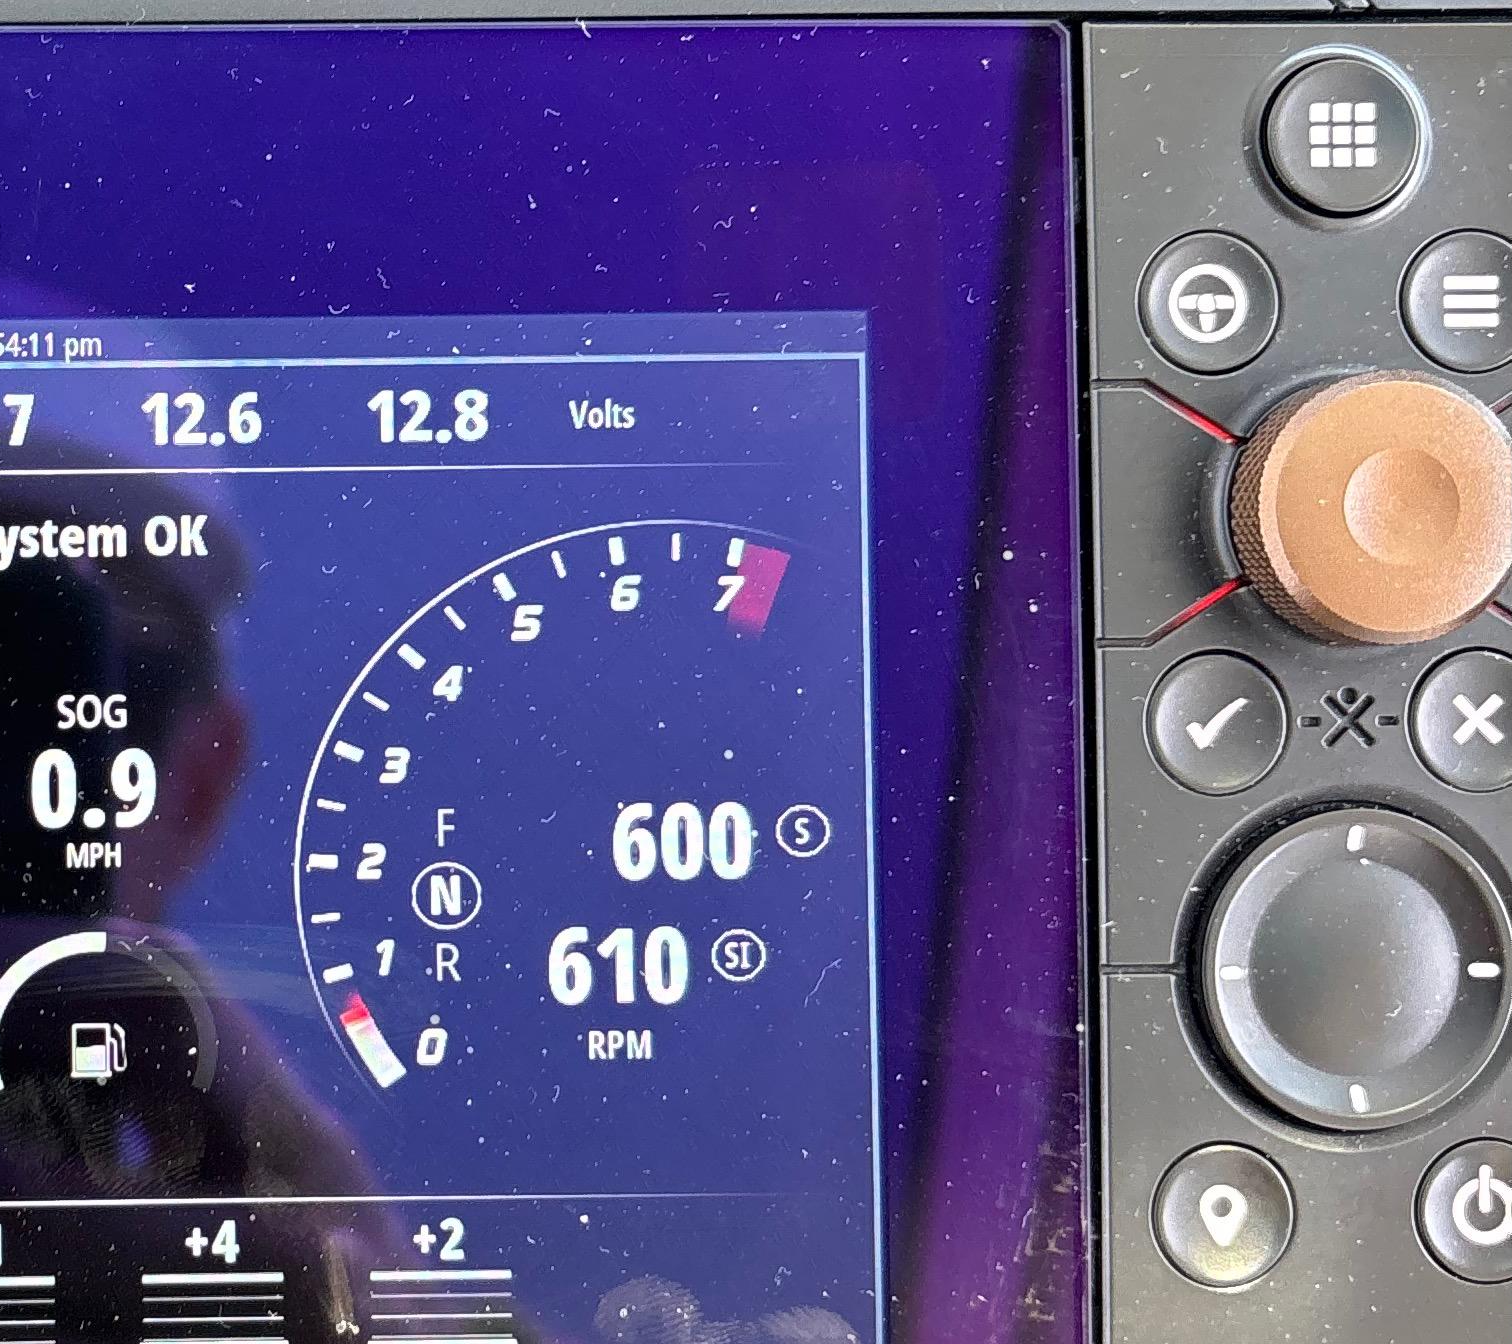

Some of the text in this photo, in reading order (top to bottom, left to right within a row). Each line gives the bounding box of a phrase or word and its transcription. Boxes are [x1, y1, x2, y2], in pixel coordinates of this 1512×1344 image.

[64, 336, 102, 362] pm
[141, 391, 263, 446] 12.6
[367, 389, 490, 444] 12.8
[568, 399, 635, 431] Volts
[143, 514, 209, 557] OK
[610, 575, 641, 611] 6
[713, 576, 744, 612] 7
[511, 604, 544, 642] 5
[433, 665, 464, 703] 4
[56, 695, 128, 730] SOG
[379, 747, 411, 784] 3
[30, 747, 157, 830] 0.9
[438, 809, 456, 848] F
[612, 802, 811, 882] 600 S
[65, 841, 122, 870] MPH
[356, 844, 388, 881] 2
[430, 875, 462, 918] N
[375, 939, 396, 976] 1
[436, 943, 462, 983] R
[548, 926, 753, 1007] 610 SI
[416, 1028, 449, 1067] 0
[587, 1029, 652, 1061] RPM
[184, 1220, 240, 1264] +4
[413, 1217, 467, 1262] +2
